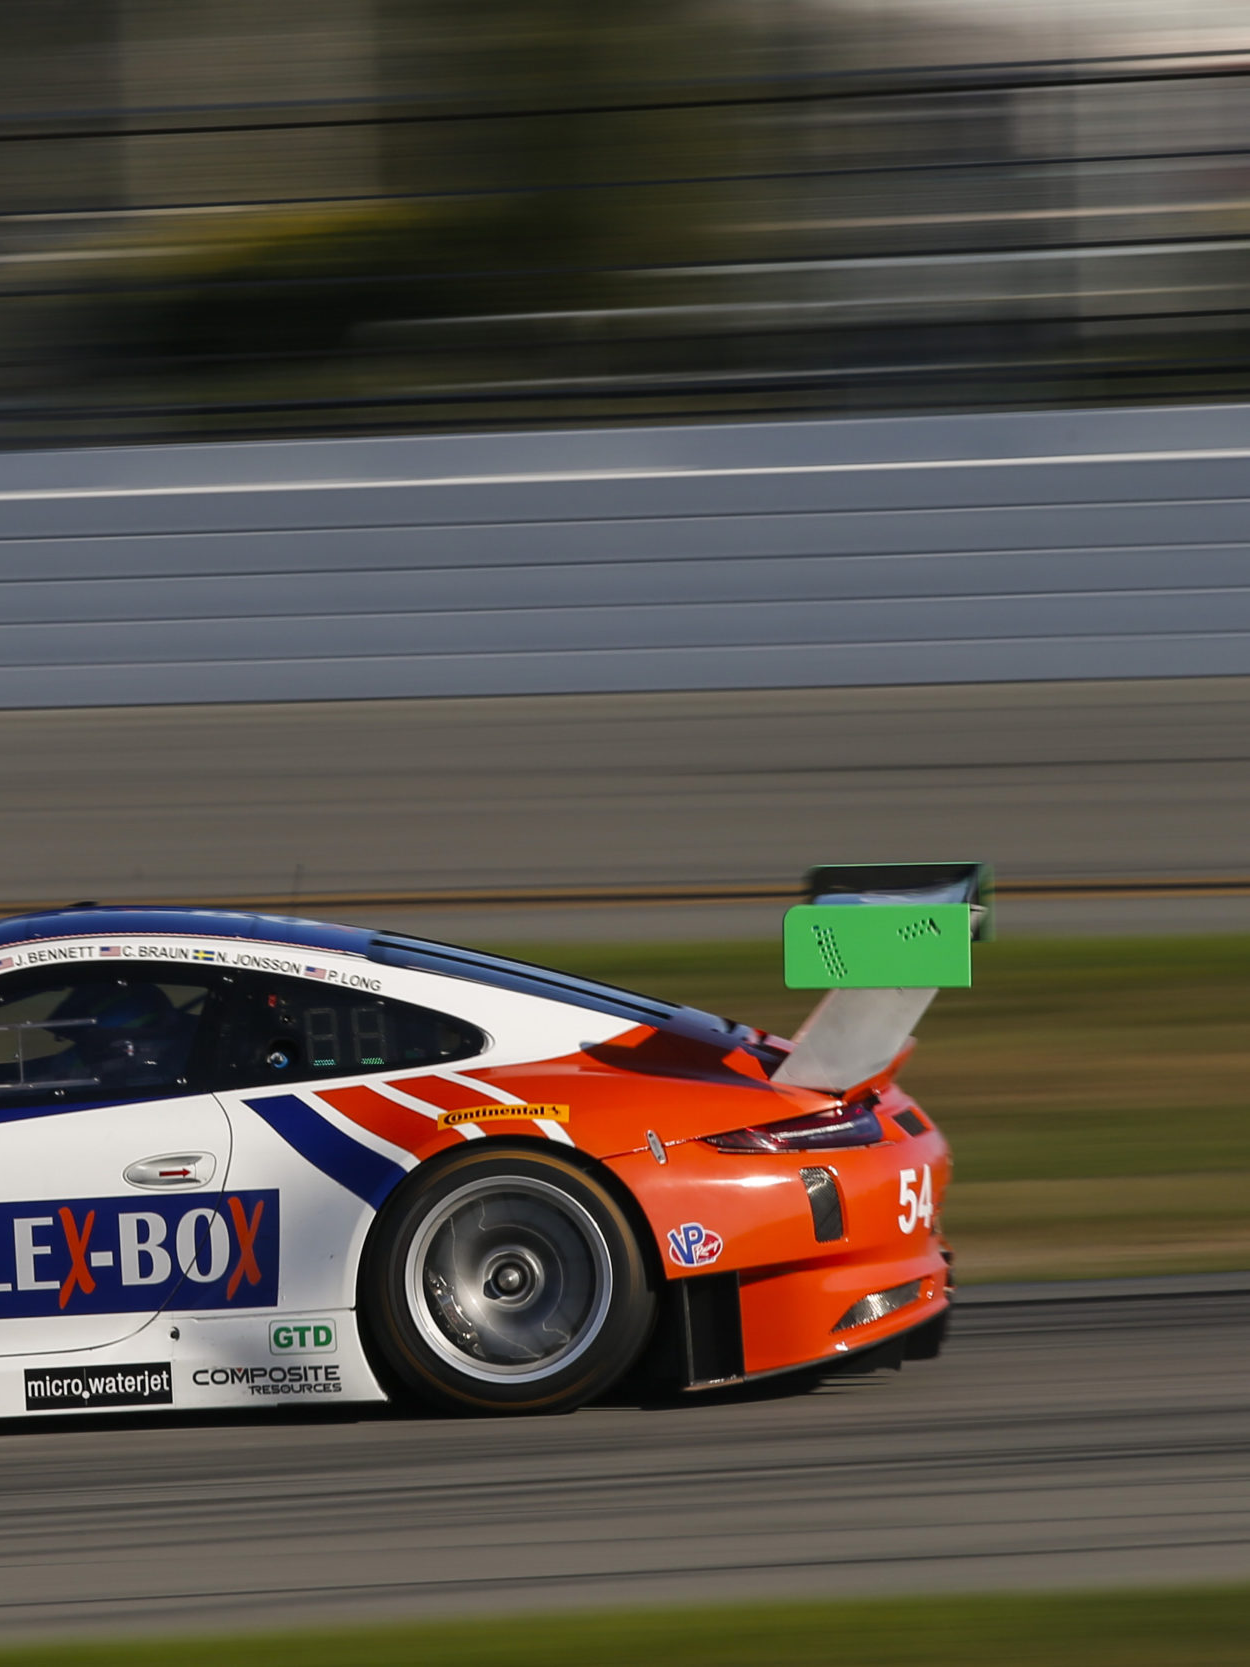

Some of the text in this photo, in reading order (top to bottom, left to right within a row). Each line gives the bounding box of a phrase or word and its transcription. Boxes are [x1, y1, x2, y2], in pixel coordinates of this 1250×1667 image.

[14, 946, 95, 967] J. BENNETT
[122, 945, 190, 960] C. BRAUN
[215, 951, 302, 975] N. JONSSON
[327, 969, 382, 992] P. LONG
[443, 1106, 545, 1125] Continental
[898, 1163, 934, 1235] 54
[668, 1224, 705, 1266] VP
[273, 1325, 333, 1348] GTD
[192, 1364, 341, 1386] COMPOSITE
[249, 1383, 342, 1395] RESOURCES
